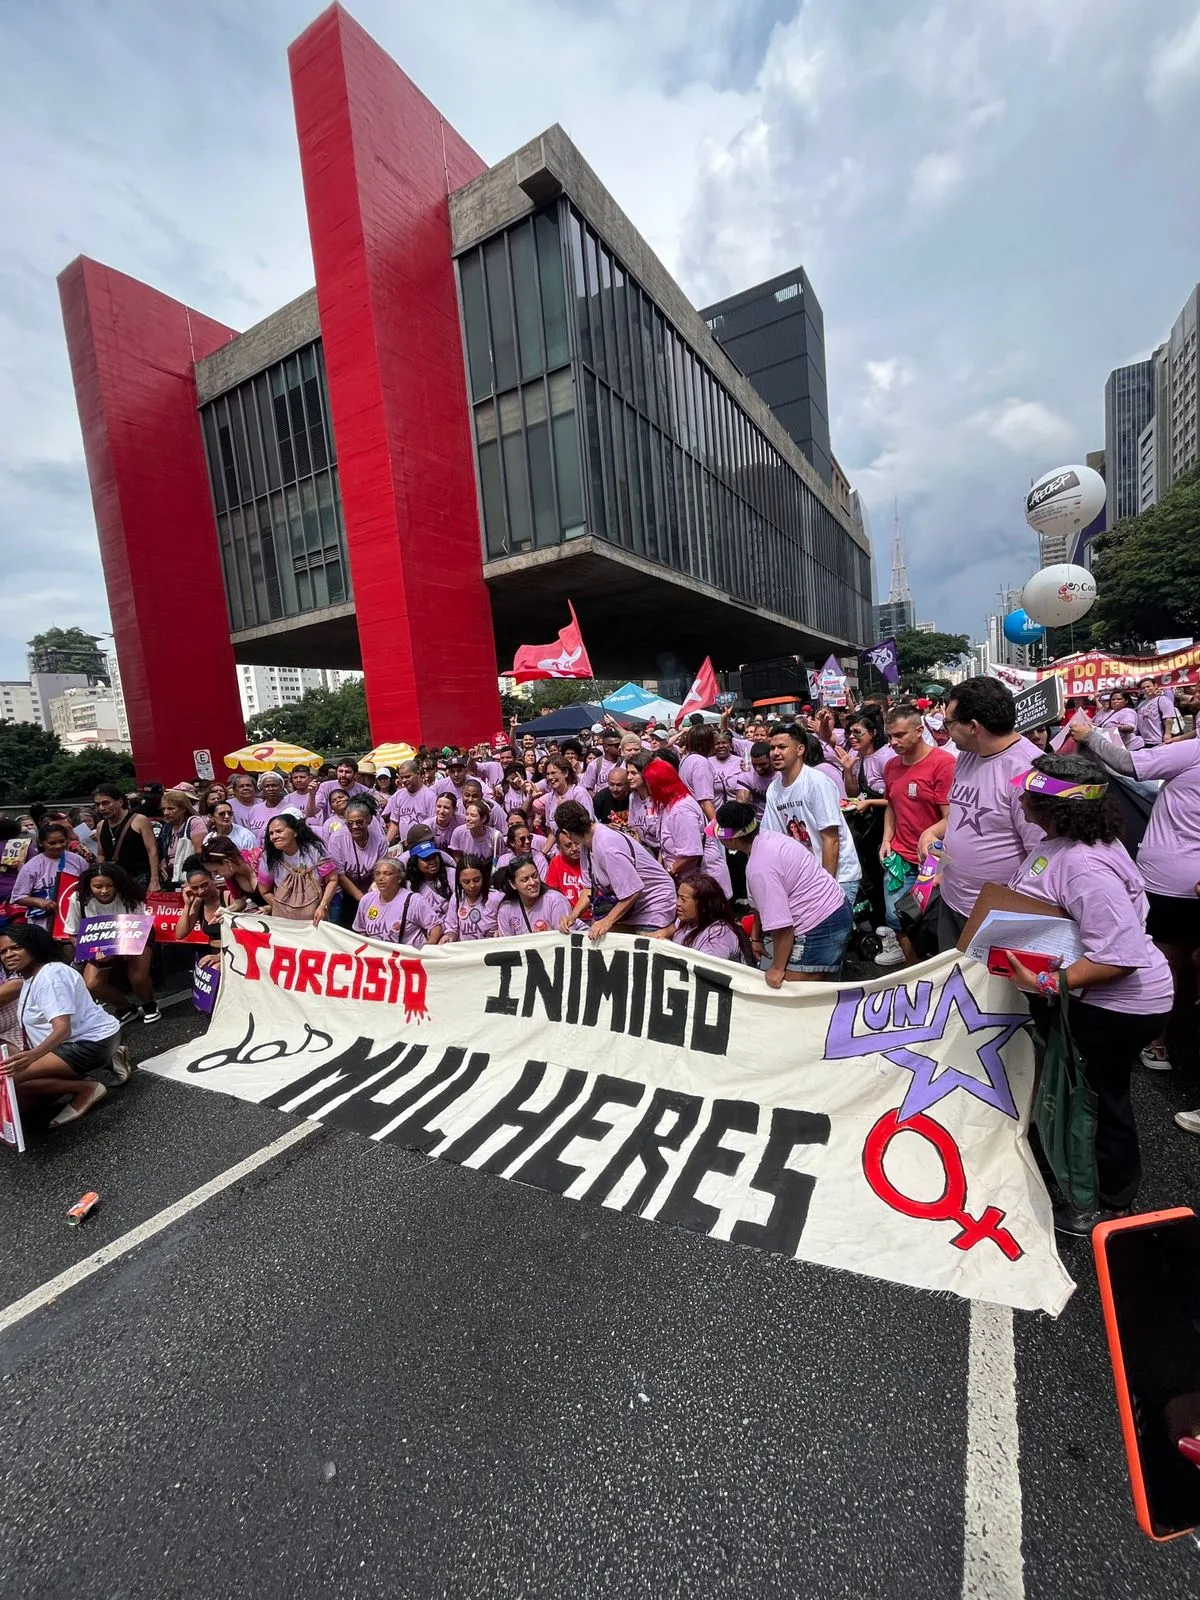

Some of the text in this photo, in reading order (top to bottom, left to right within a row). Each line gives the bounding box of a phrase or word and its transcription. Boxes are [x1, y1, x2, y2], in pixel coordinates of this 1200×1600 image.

[1074, 663, 1096, 678] DO
[1073, 680, 1094, 693] DA
[1161, 671, 1172, 684] 6
[1177, 669, 1190, 683] X
[79, 930, 143, 944] NOS MATAR
[186, 1012, 831, 1258] das MULHERES
